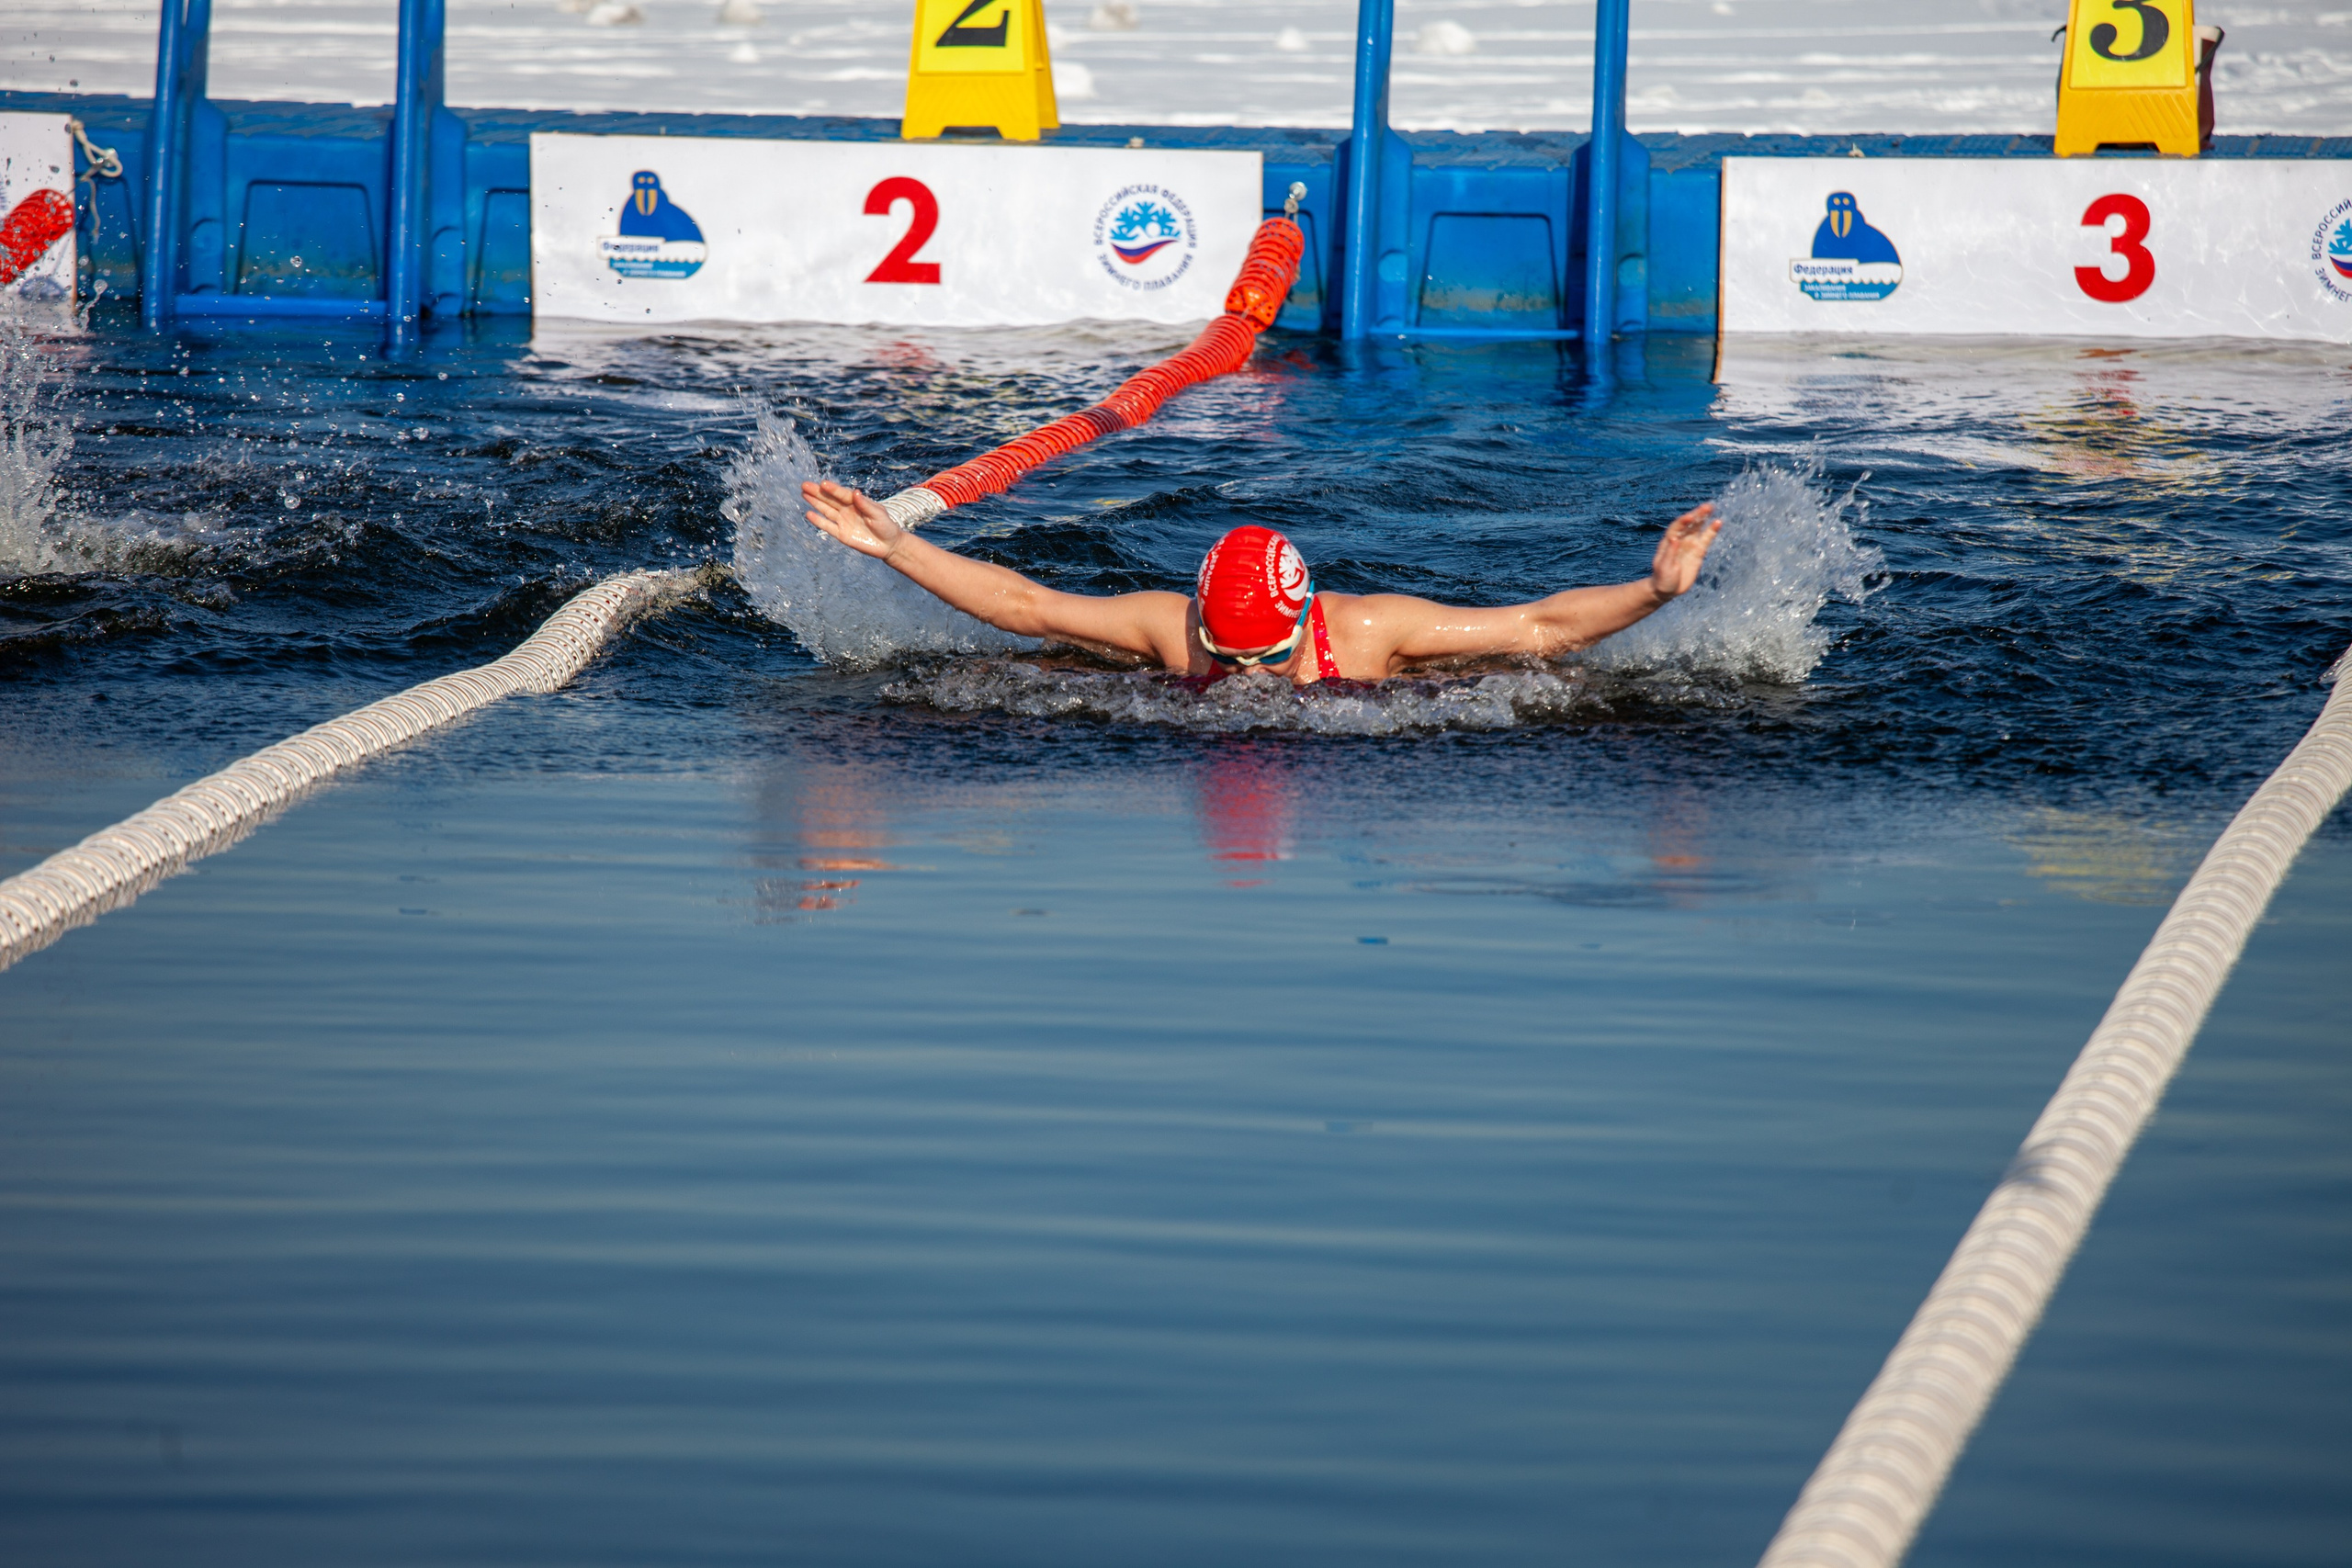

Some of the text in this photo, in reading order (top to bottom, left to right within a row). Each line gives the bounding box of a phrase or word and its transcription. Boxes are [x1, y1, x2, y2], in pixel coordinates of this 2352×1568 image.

[2089, 0, 2169, 62] 3
[862, 176, 941, 285] 2
[1093, 184, 1197, 248] ВСЕРОССИЙСКАЯ ФЕДЕРАЦИЯ
[2312, 197, 2352, 260] ВСЕРОССИЙ
[1098, 253, 1193, 291] ЗИМНЕГО ПЛАВАНИЯ
[1793, 264, 1853, 276] Федерация
[2074, 193, 2155, 303] 3
[2315, 266, 2352, 303] ЗИМНЕГ
